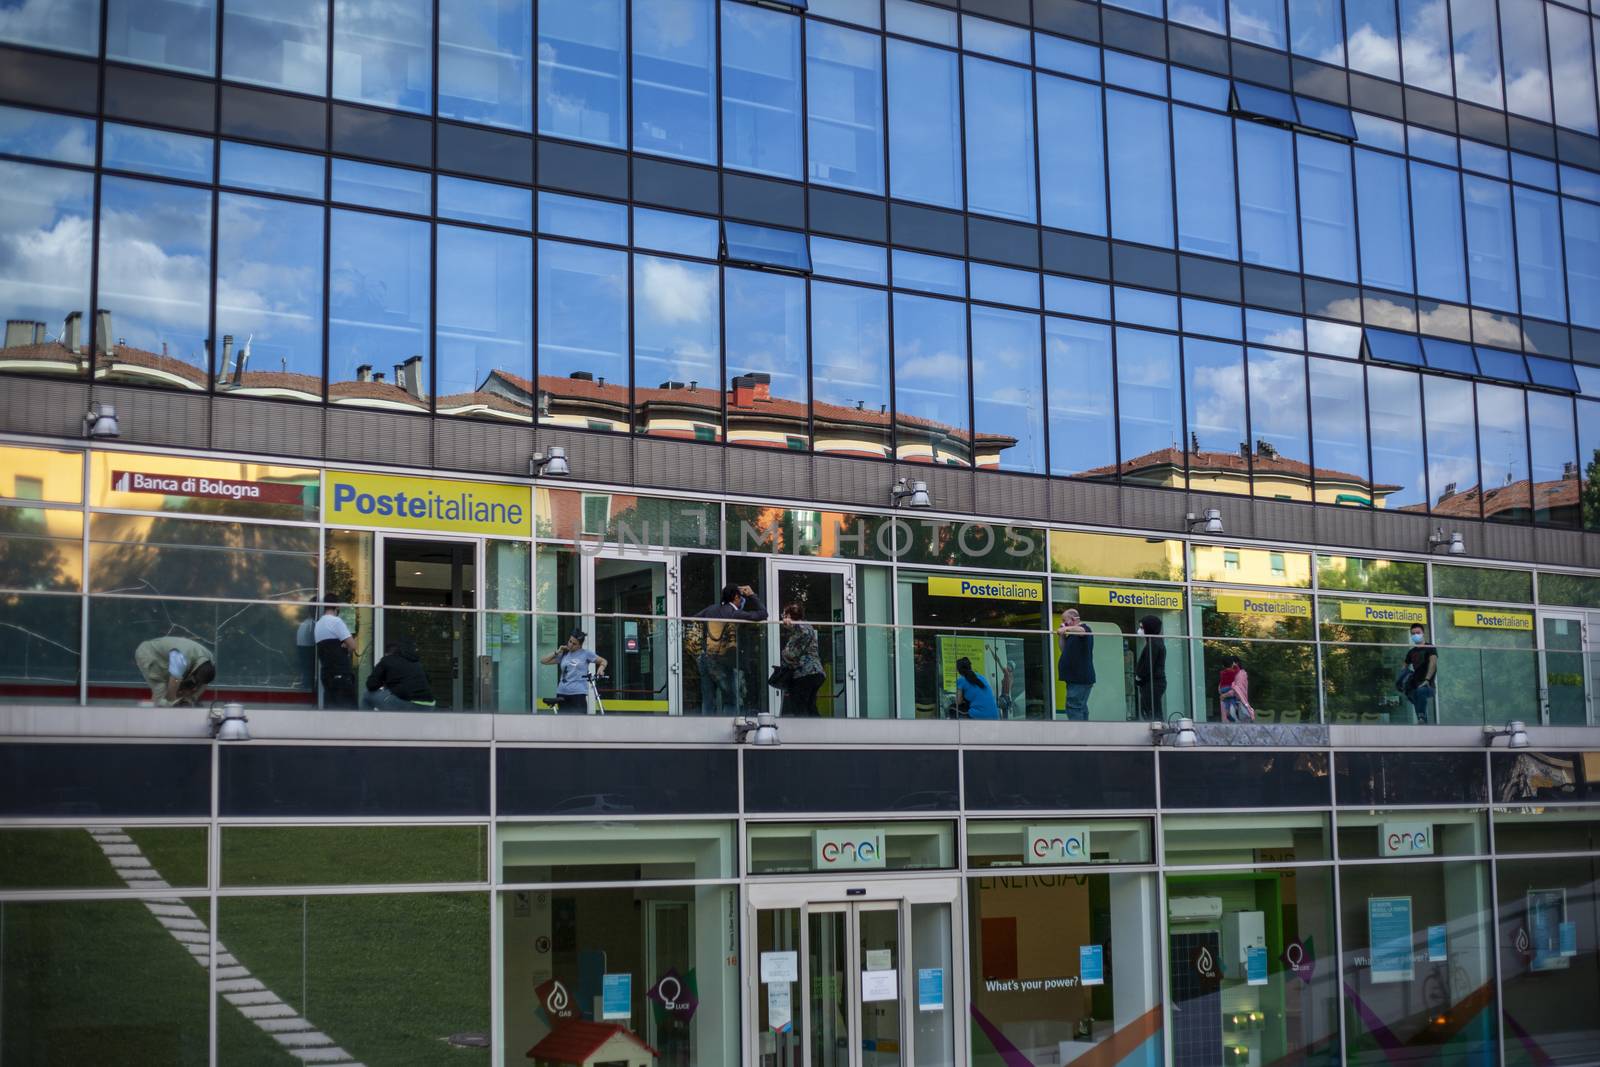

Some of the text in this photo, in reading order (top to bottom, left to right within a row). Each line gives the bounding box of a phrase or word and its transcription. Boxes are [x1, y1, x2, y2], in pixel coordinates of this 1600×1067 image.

[134, 474, 260, 499] Banca di Bologna
[333, 483, 522, 525] Posteitaliane
[960, 581, 1039, 599] Posteitaliane
[1108, 590, 1178, 608] Posteitaliane
[1243, 599, 1307, 616] Posteitaliane
[1364, 606, 1423, 622] Posteitaliane
[822, 835, 881, 862] enel
[1033, 831, 1086, 858] enel
[1388, 826, 1431, 851] enel
[985, 976, 1079, 993] What's your power?
